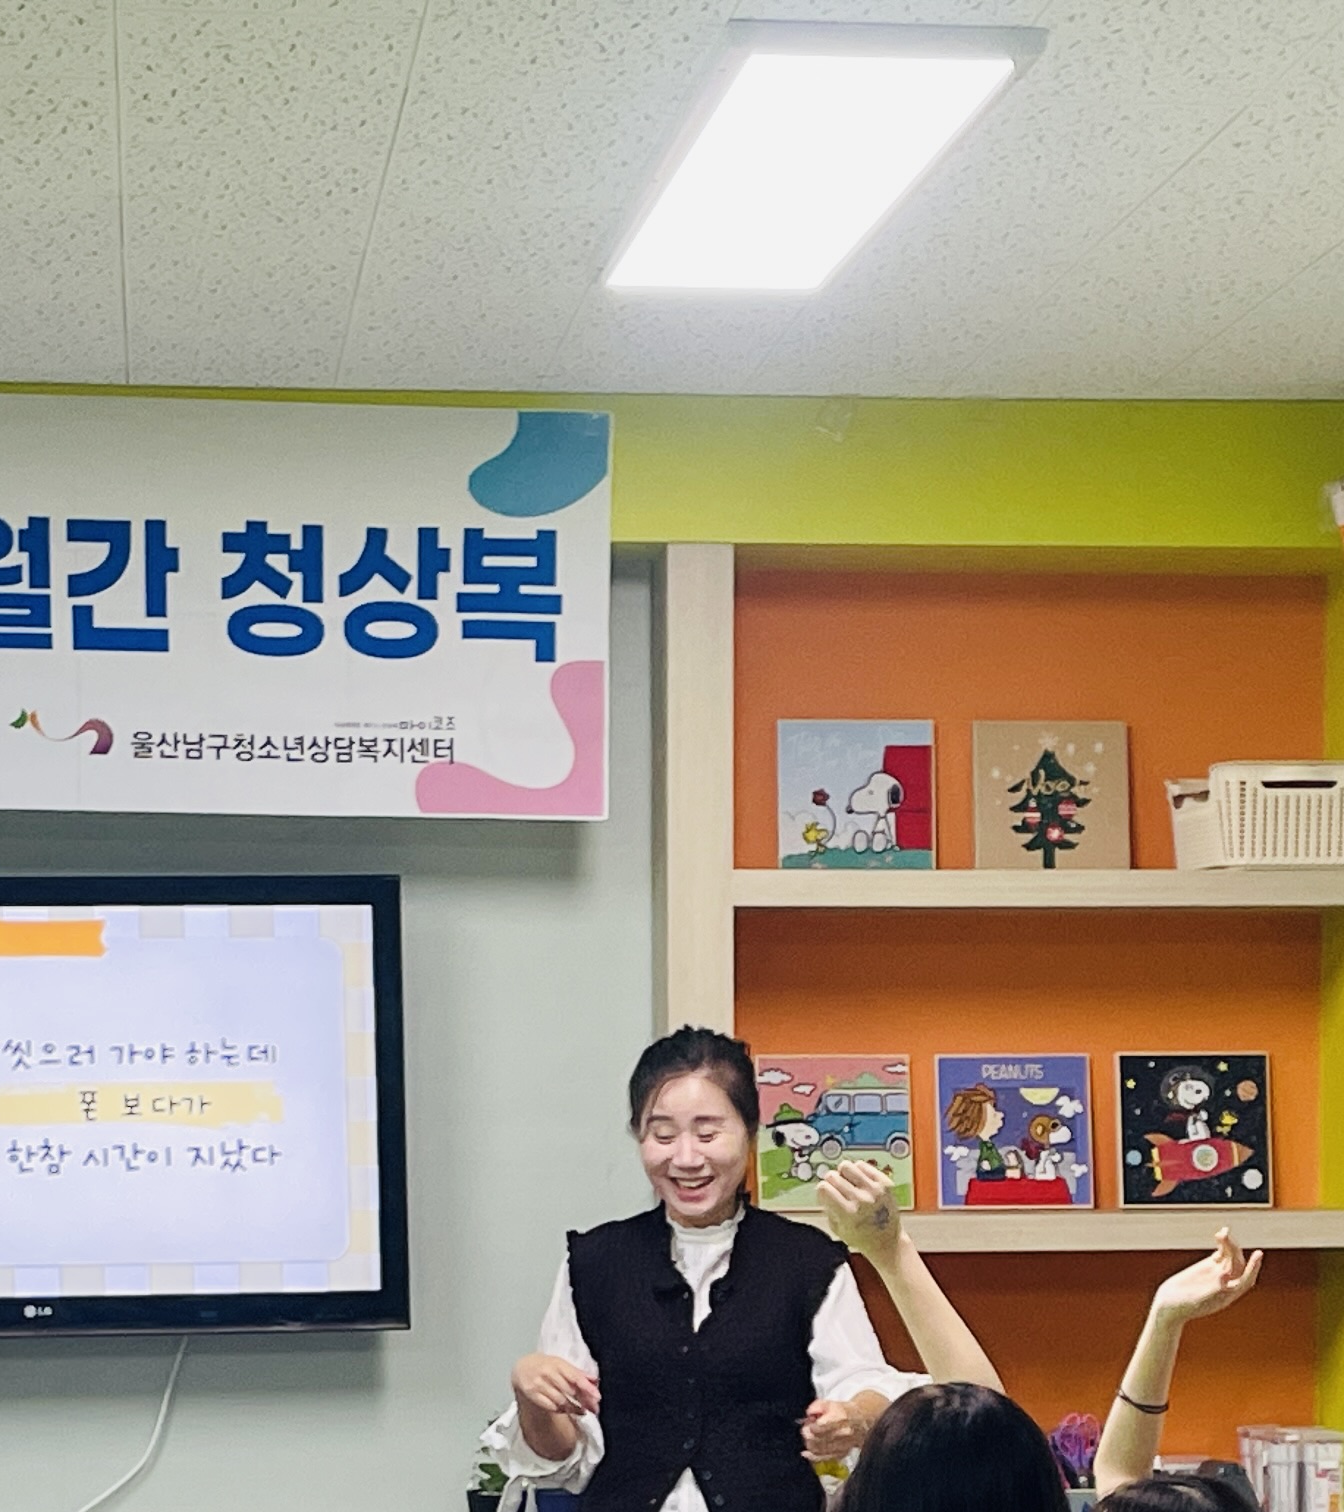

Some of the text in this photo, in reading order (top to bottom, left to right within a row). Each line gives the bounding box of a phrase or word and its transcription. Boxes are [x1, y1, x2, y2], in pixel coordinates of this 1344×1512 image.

[221, 520, 563, 662] 청상복
[129, 730, 456, 765] 울산남구청소년상담복지센터
[2, 1037, 278, 1071] 씻으러 가야 하는데
[981, 1063, 1045, 1081] PEANUTS
[79, 1090, 98, 1121] 폰
[6, 1138, 283, 1175] 한참 시간이 지났다
